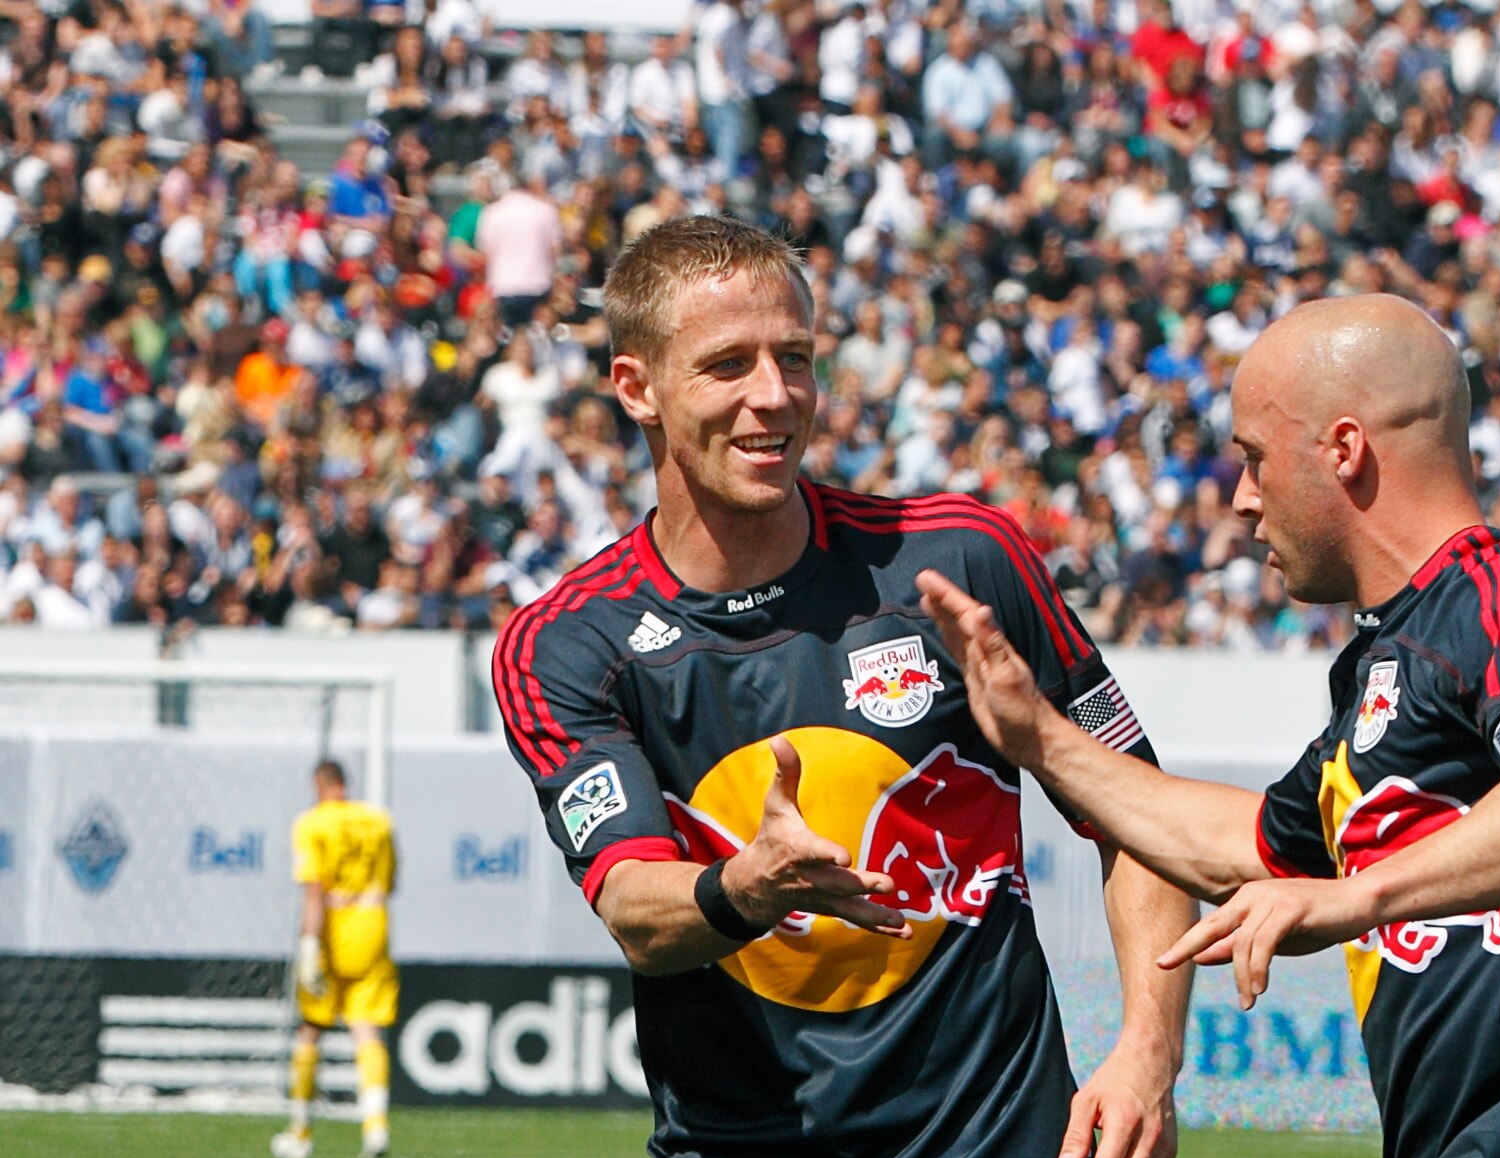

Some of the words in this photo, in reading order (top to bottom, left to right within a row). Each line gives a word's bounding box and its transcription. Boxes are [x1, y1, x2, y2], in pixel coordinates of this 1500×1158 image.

[727, 595, 755, 613] Red
[754, 585, 785, 606] Bulls
[887, 646, 918, 665] Bull
[574, 797, 621, 845] MLS
[1195, 1004, 1369, 1078] BM
